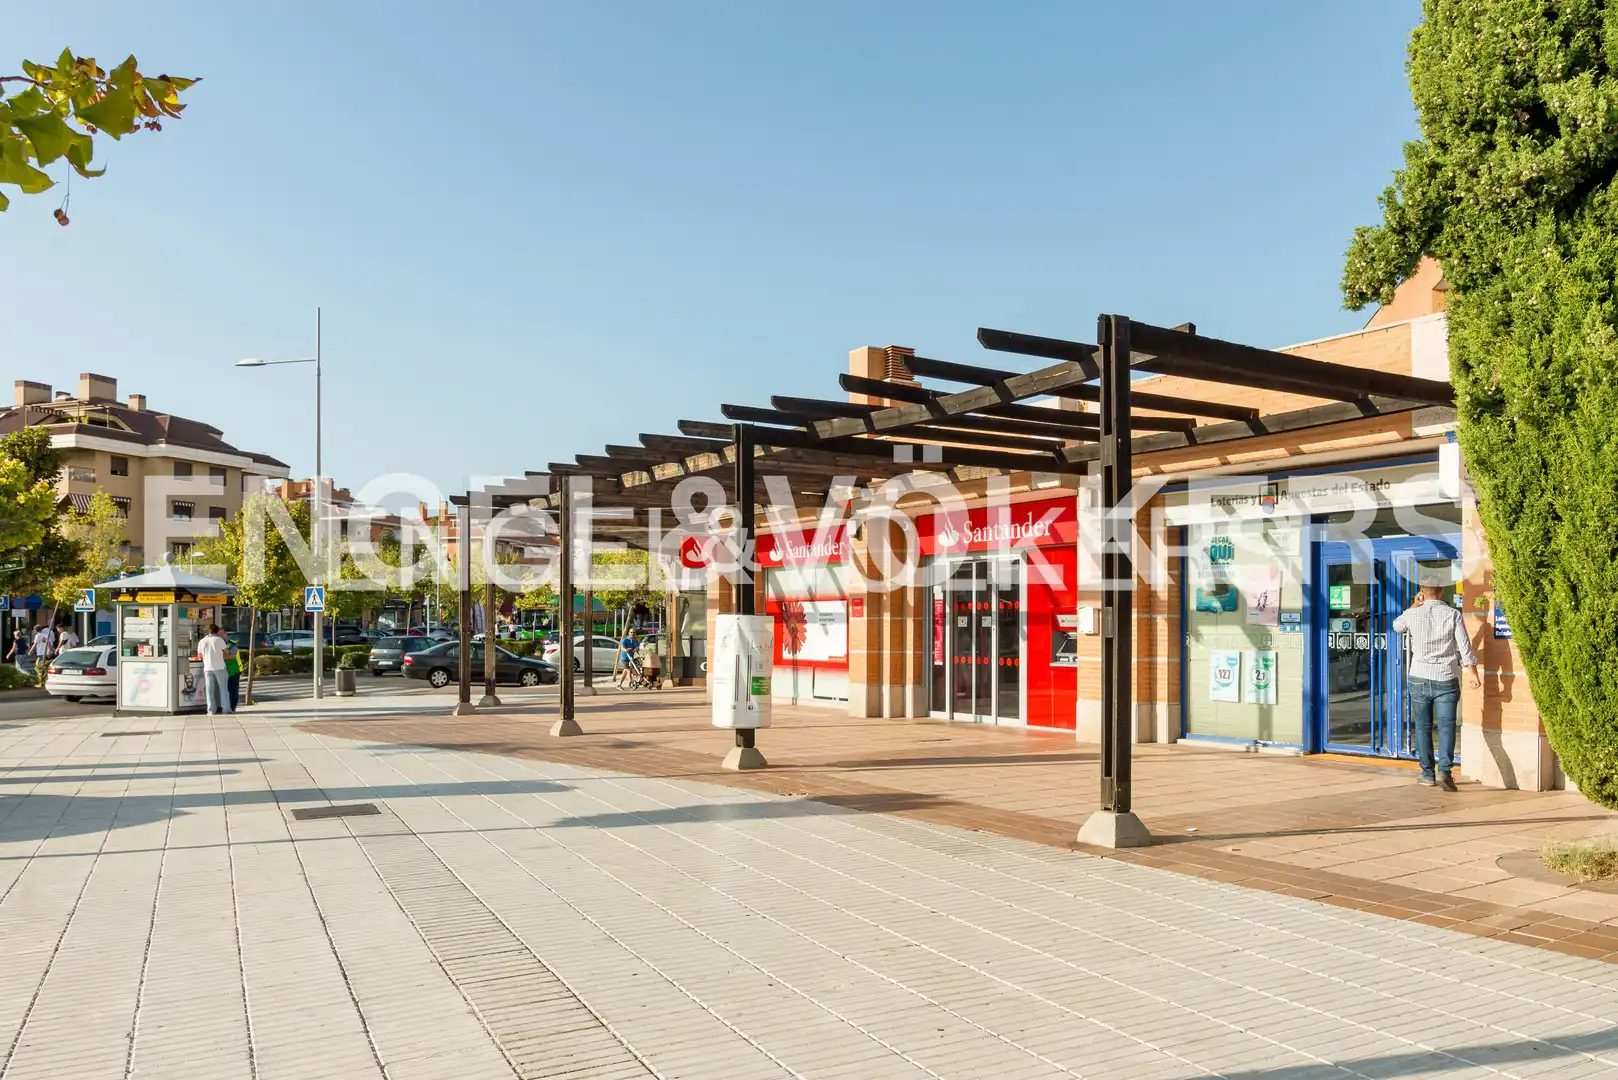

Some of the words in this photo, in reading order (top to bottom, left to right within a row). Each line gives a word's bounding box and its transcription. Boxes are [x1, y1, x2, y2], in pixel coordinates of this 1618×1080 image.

[1211, 494, 1248, 507] Loterías
[1281, 486, 1329, 501] Apuestas
[1332, 482, 1347, 496] del
[1351, 478, 1391, 493] Estado
[963, 511, 1053, 544] Santander
[786, 535, 845, 559] Santander
[1218, 668, 1231, 680] 127
